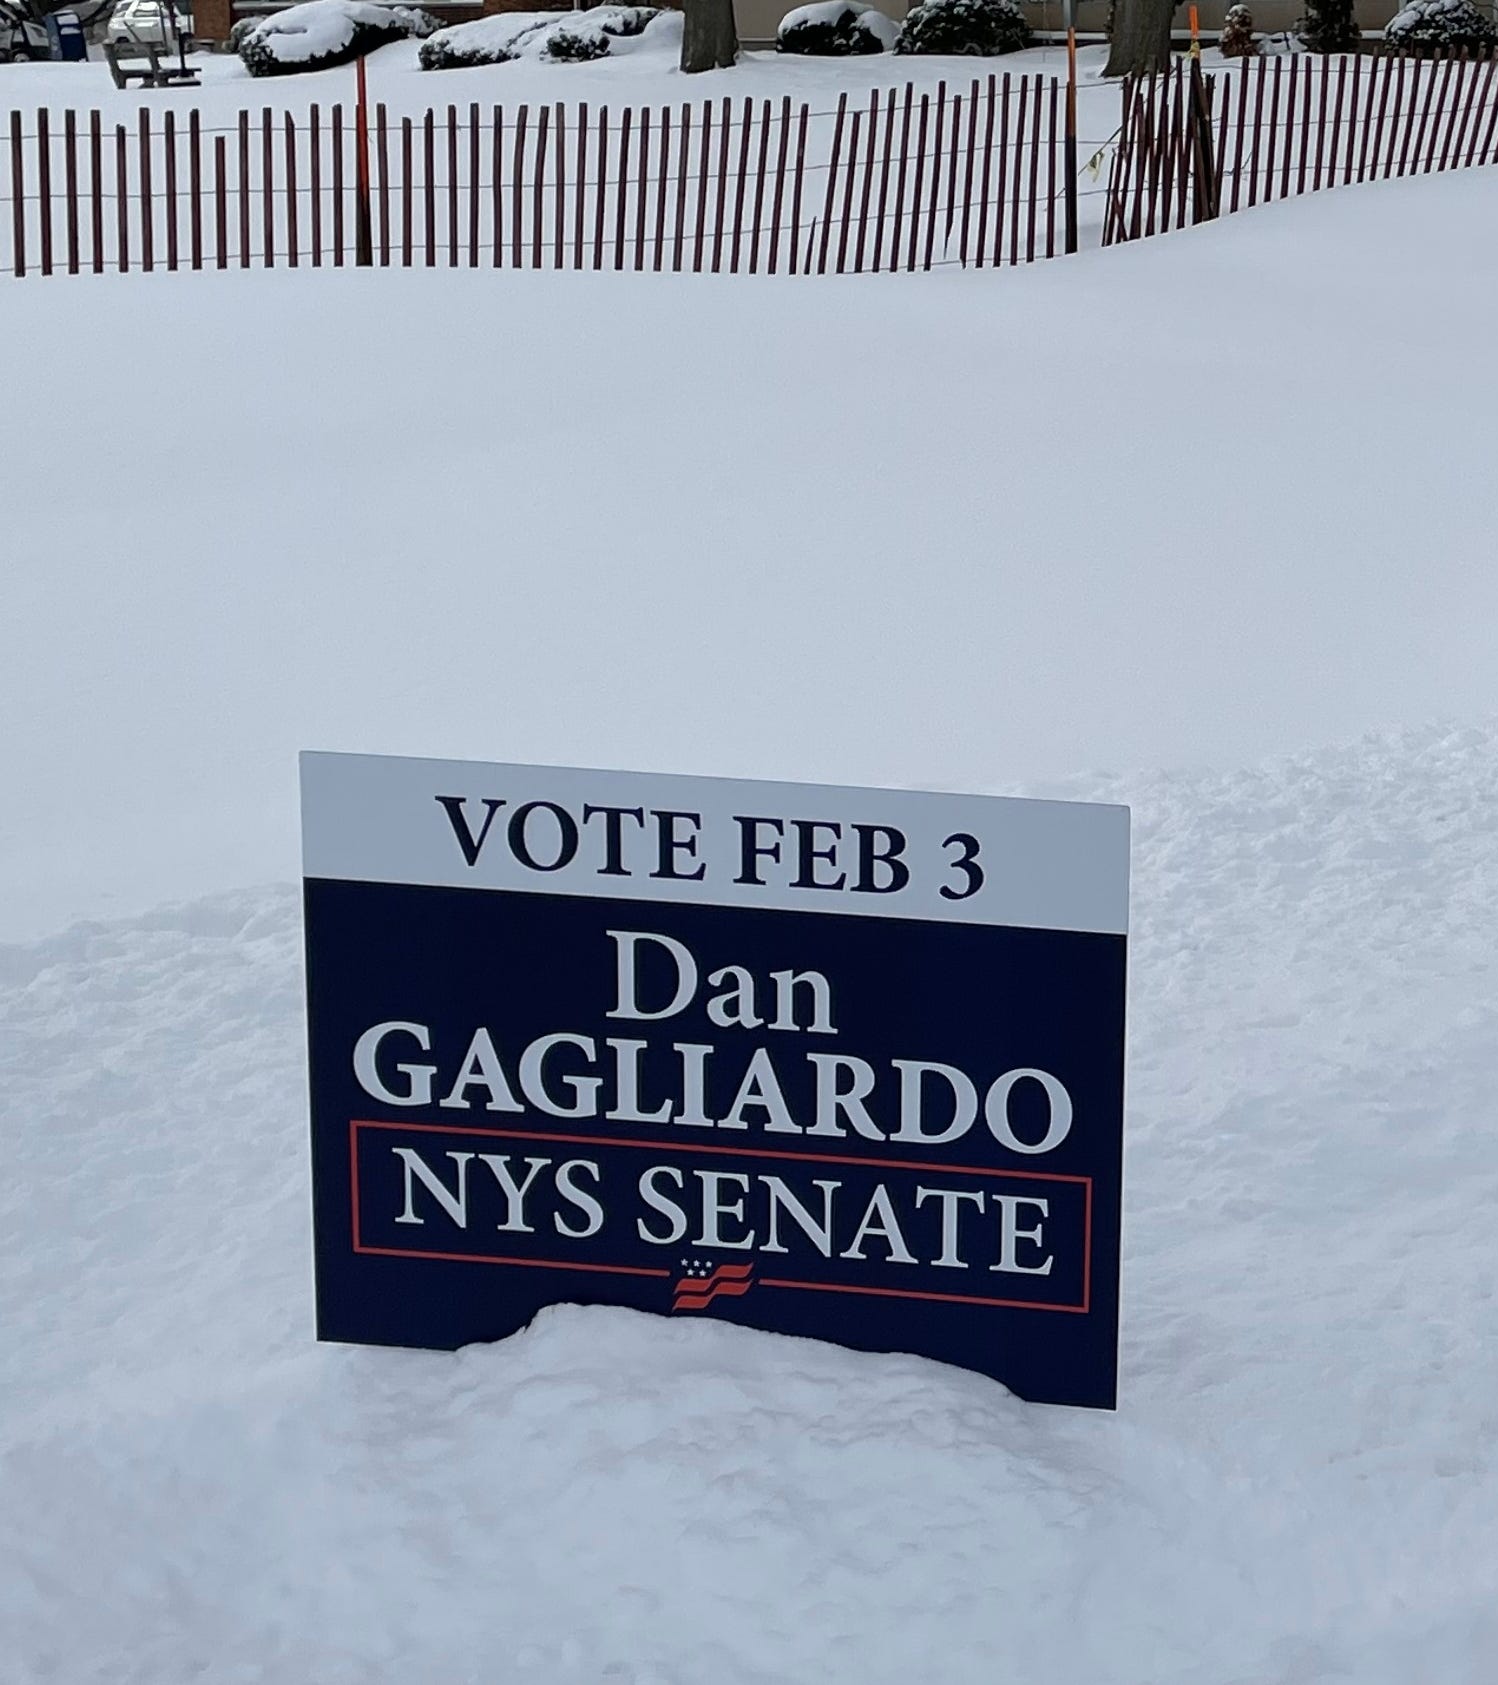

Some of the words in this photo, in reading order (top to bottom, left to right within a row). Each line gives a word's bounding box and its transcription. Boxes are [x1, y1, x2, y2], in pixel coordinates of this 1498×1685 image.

[434, 795, 708, 882] VOTE
[732, 815, 912, 894] FEB
[938, 833, 986, 901] 3
[605, 929, 839, 1035] Dan
[352, 1021, 1074, 1155] GAGLIARDO
[391, 1147, 604, 1239] NYS
[636, 1165, 1056, 1276] SENATE
